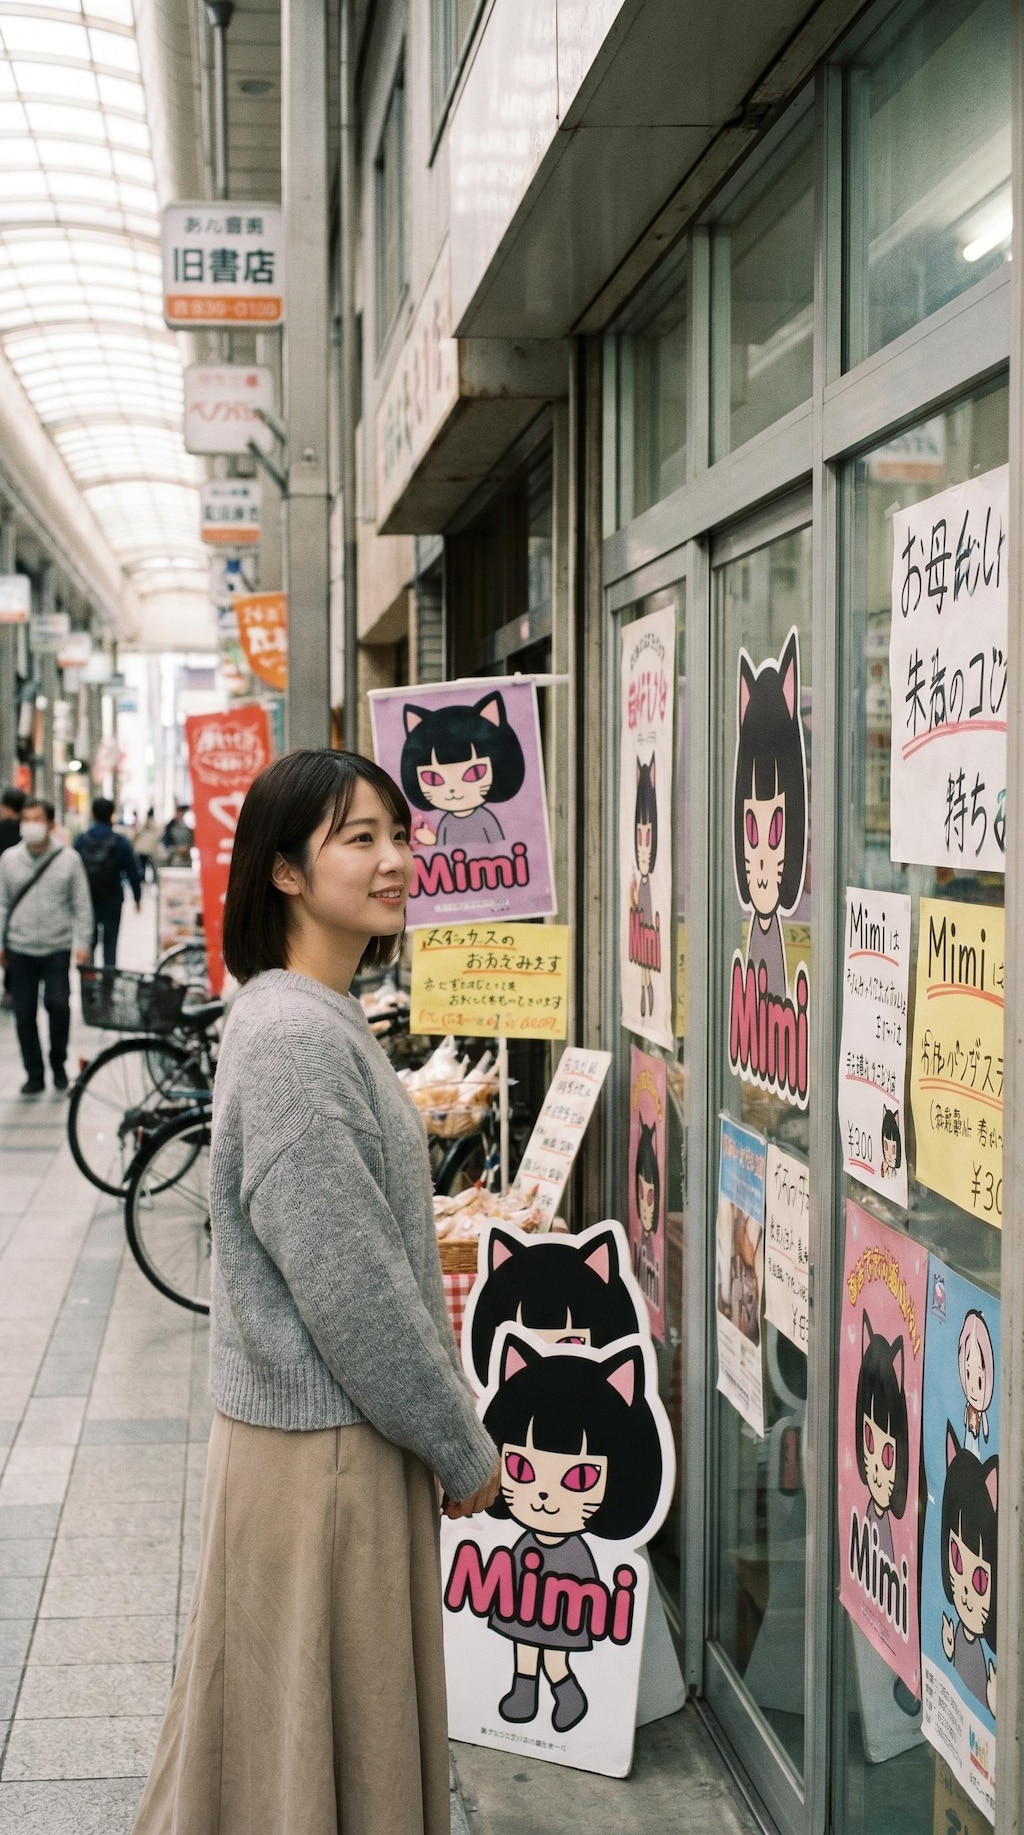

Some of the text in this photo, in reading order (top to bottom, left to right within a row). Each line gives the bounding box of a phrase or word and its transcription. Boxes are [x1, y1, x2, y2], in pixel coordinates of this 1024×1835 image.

[173, 248, 275, 284] 旧書店
[408, 842, 530, 898] Mimi
[628, 906, 661, 973] Mimi
[850, 901, 900, 954] Mimi は
[929, 915, 986, 991] Mimi
[729, 955, 808, 1102] Mimi
[848, 1119, 873, 1162] ¥300
[444, 1539, 638, 1645] Mimi
[850, 1508, 909, 1641] Mimi
